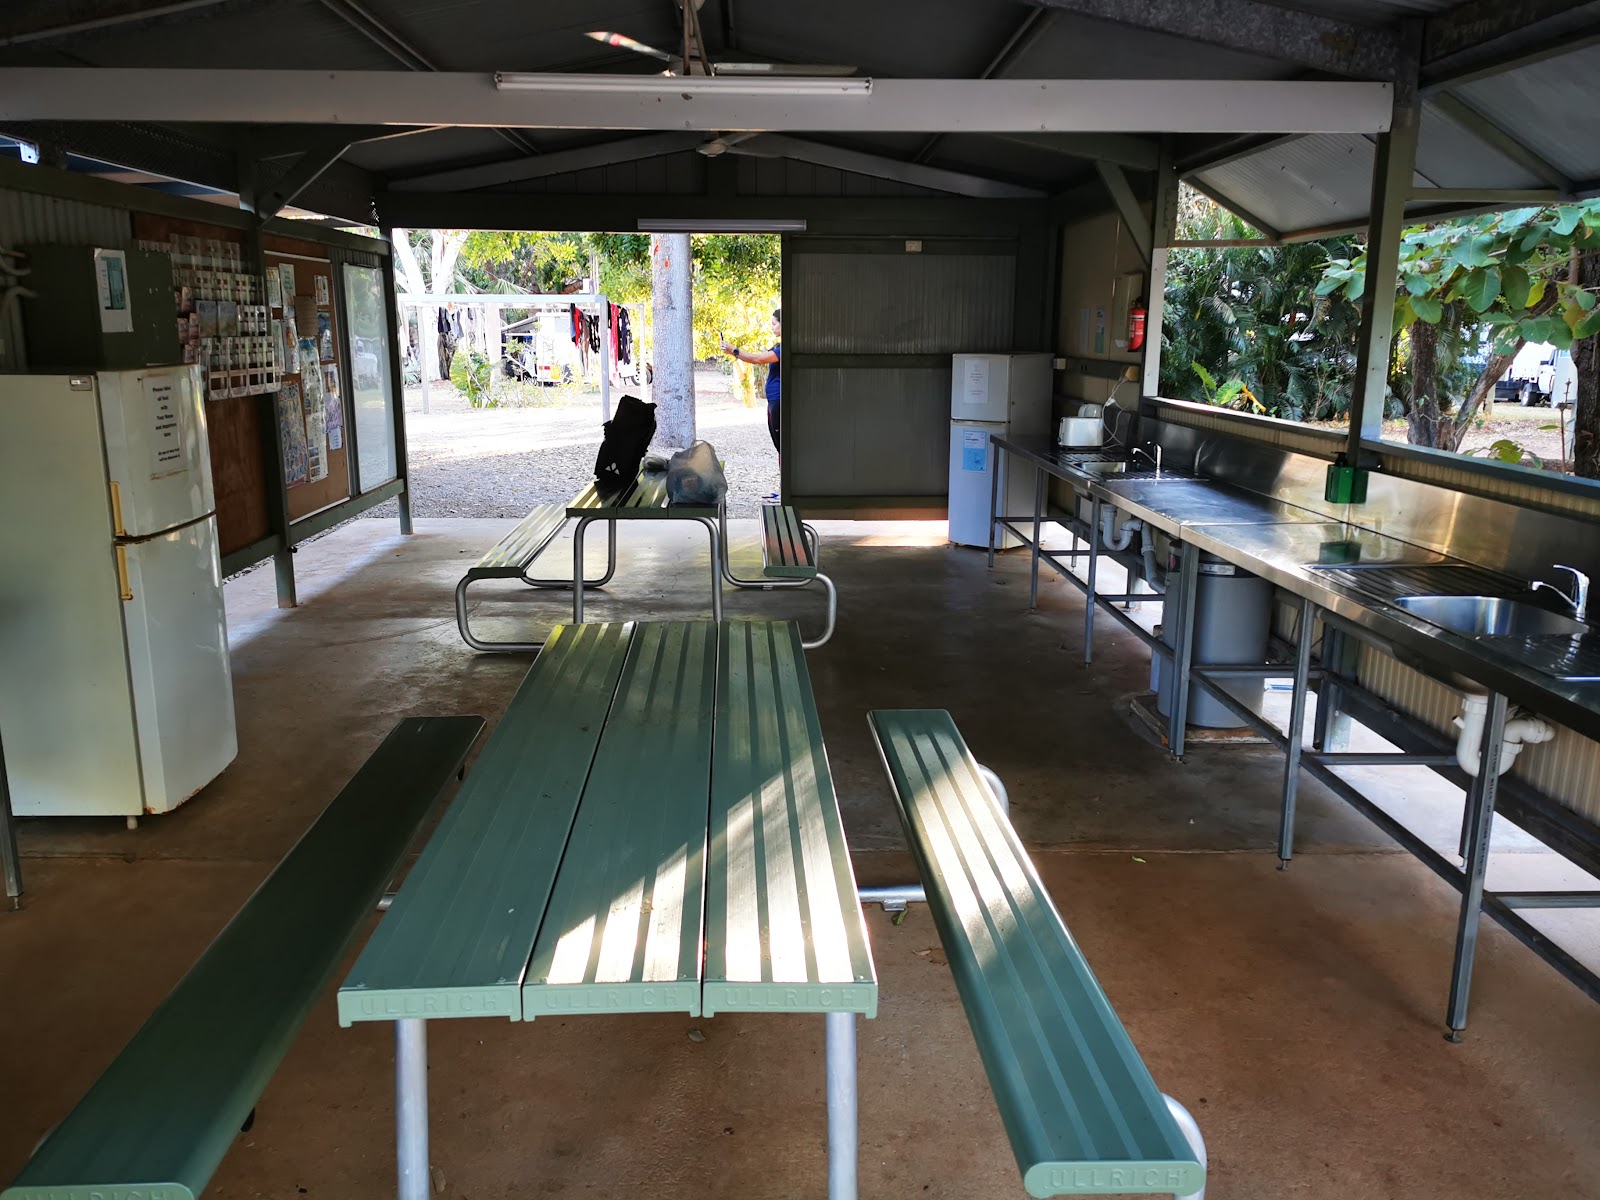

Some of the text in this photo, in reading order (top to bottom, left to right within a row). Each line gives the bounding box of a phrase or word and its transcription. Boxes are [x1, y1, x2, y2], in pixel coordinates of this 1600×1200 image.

[360, 992, 499, 1015] ULLRICH
[544, 987, 679, 1010] ULLRICH
[724, 987, 856, 1007] ULLRICH
[1050, 1167, 1181, 1188] ULLRICH
